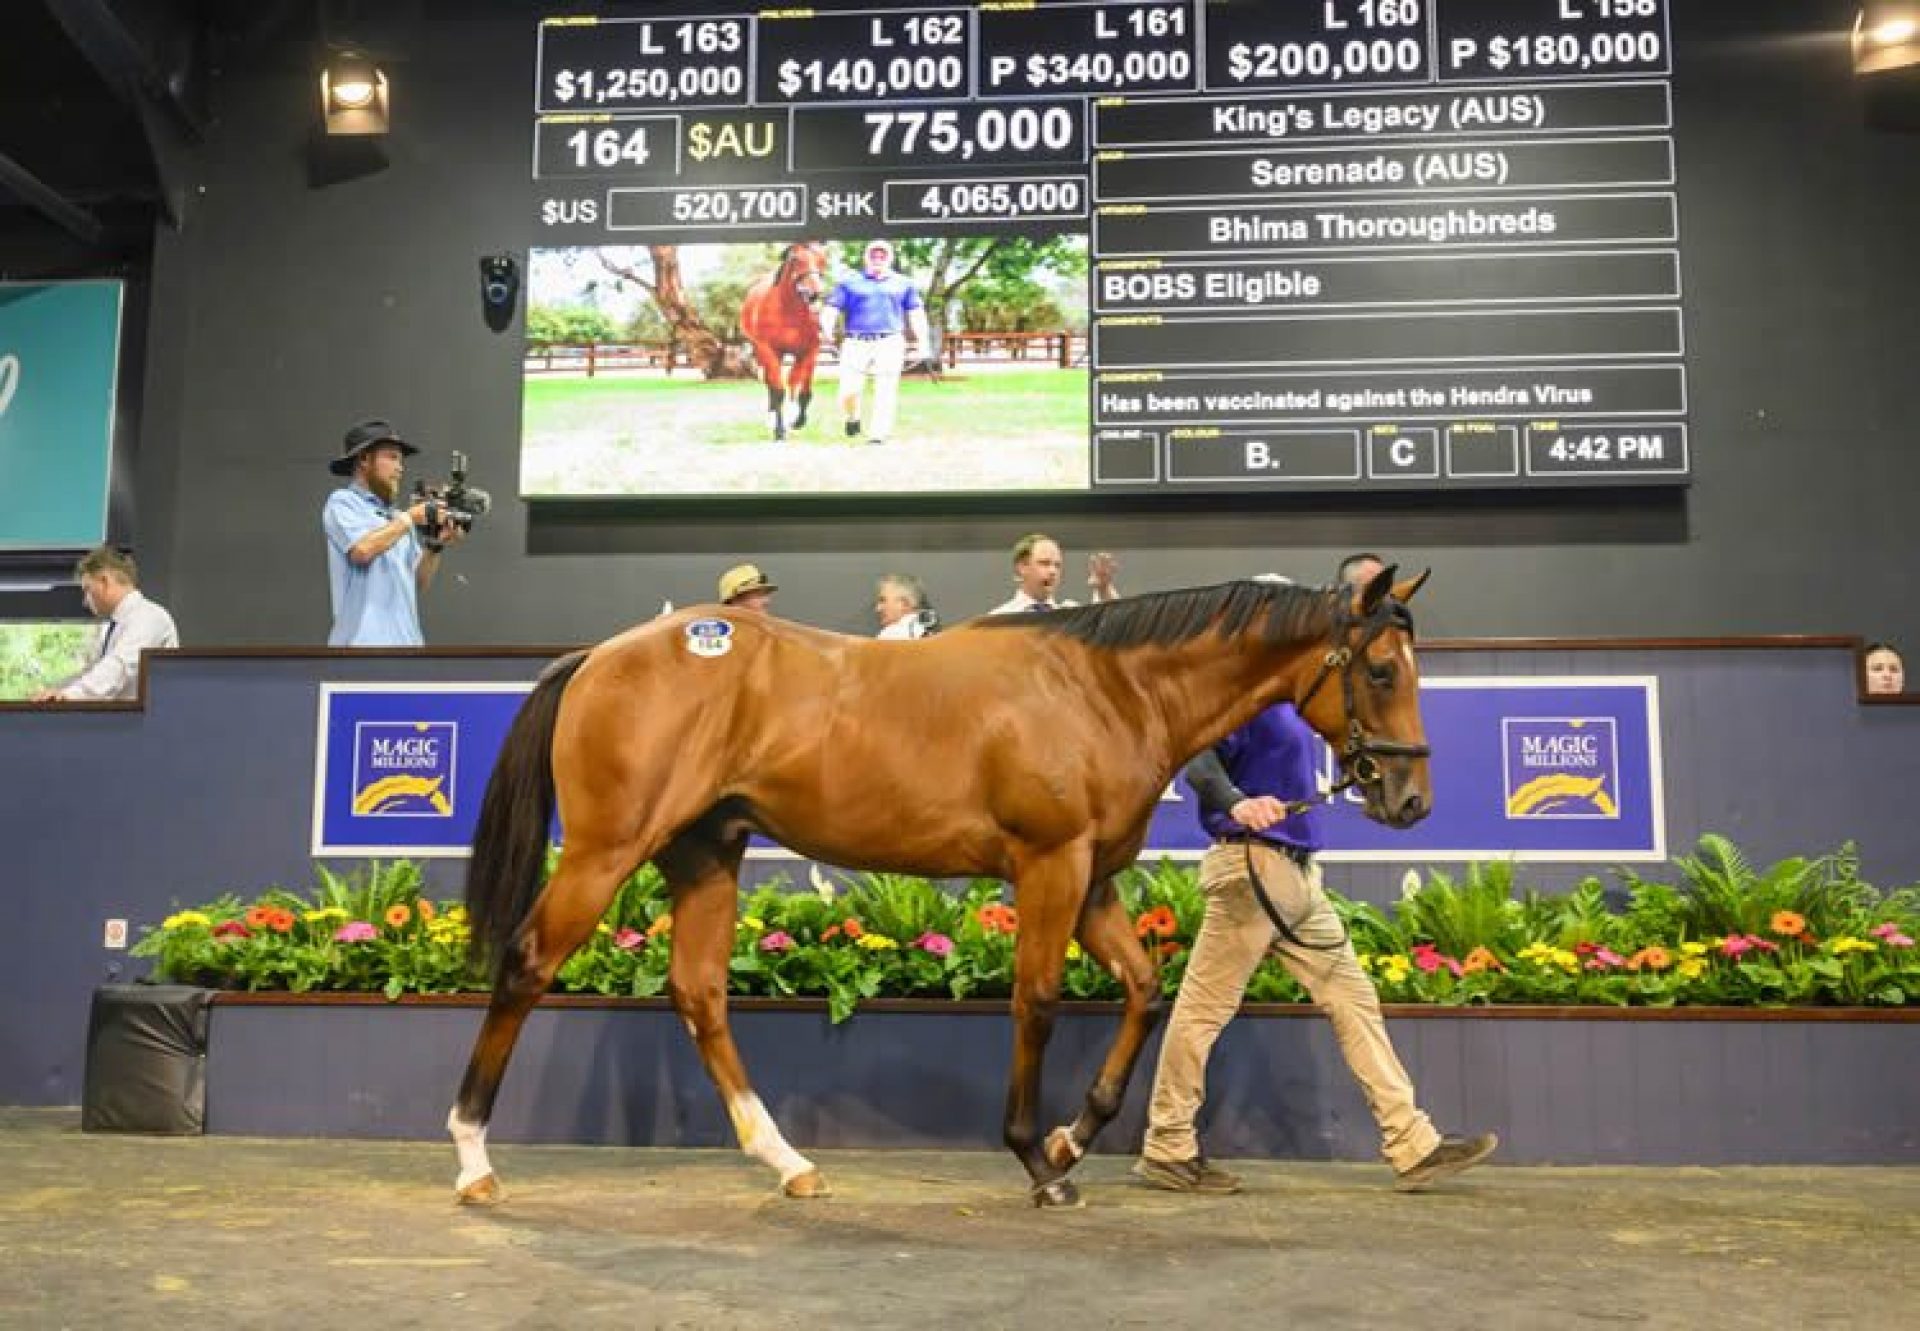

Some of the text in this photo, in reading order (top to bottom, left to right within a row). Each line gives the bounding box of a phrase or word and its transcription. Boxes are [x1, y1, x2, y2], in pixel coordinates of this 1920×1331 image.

[1095, 7, 1184, 39] L 161
[1325, 0, 1419, 29] L 160
[639, 22, 741, 55] L 163
[872, 16, 963, 47] L 162
[1228, 37, 1420, 83] $200,000
[1451, 32, 1660, 70] P $180,000
[554, 66, 743, 104] $1,250,000
[777, 55, 964, 98] $140,000
[990, 50, 1191, 88] P $340,000
[1213, 94, 1545, 137] King's Legacy (AUS)
[567, 127, 649, 167] 164
[688, 122, 774, 162] $AU
[864, 107, 1073, 160] 775,000
[1251, 152, 1509, 186] Serenade (AUS)
[542, 199, 598, 226] $US
[673, 191, 797, 224] 520,700
[816, 191, 874, 219] $HK
[920, 181, 1079, 218] 4,065,000
[1210, 208, 1558, 245] Bhima Thoroughbreds
[1105, 270, 1320, 303] BOBS Eligible
[1102, 385, 1593, 413] Has been vaccinated against the Hendra Virus
[1246, 442, 1279, 469] B.
[1389, 437, 1414, 467] C
[1548, 435, 1663, 461] 4:42 PM
[372, 737, 439, 756] MAGIC
[1521, 735, 1597, 753] MAGIC
[1522, 753, 1597, 767] MILLIONS
